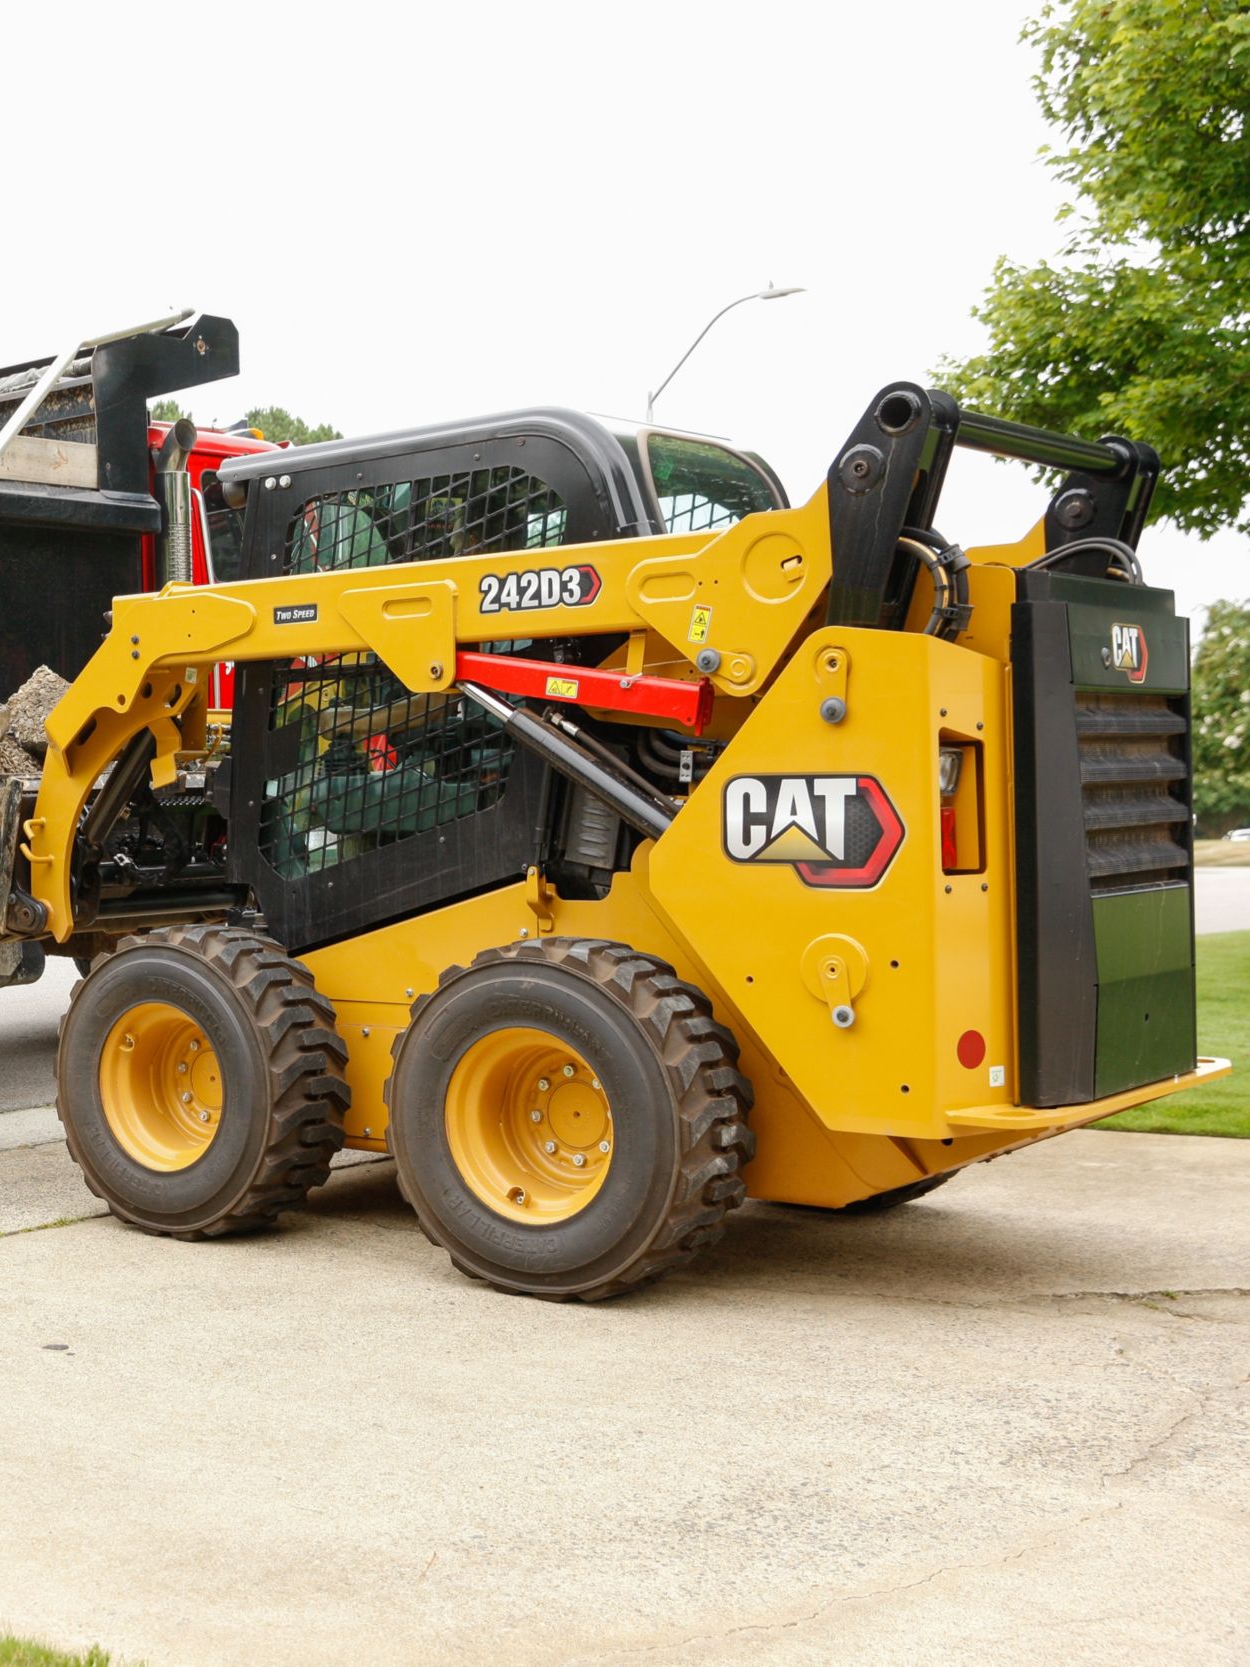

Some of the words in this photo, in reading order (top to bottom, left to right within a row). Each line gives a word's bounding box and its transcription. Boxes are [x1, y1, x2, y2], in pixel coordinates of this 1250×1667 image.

[480, 567, 581, 612] 242D3
[1111, 625, 1138, 668] CAT
[725, 777, 857, 861] CAT
[446, 1194, 558, 1256] CATERPILLAR
